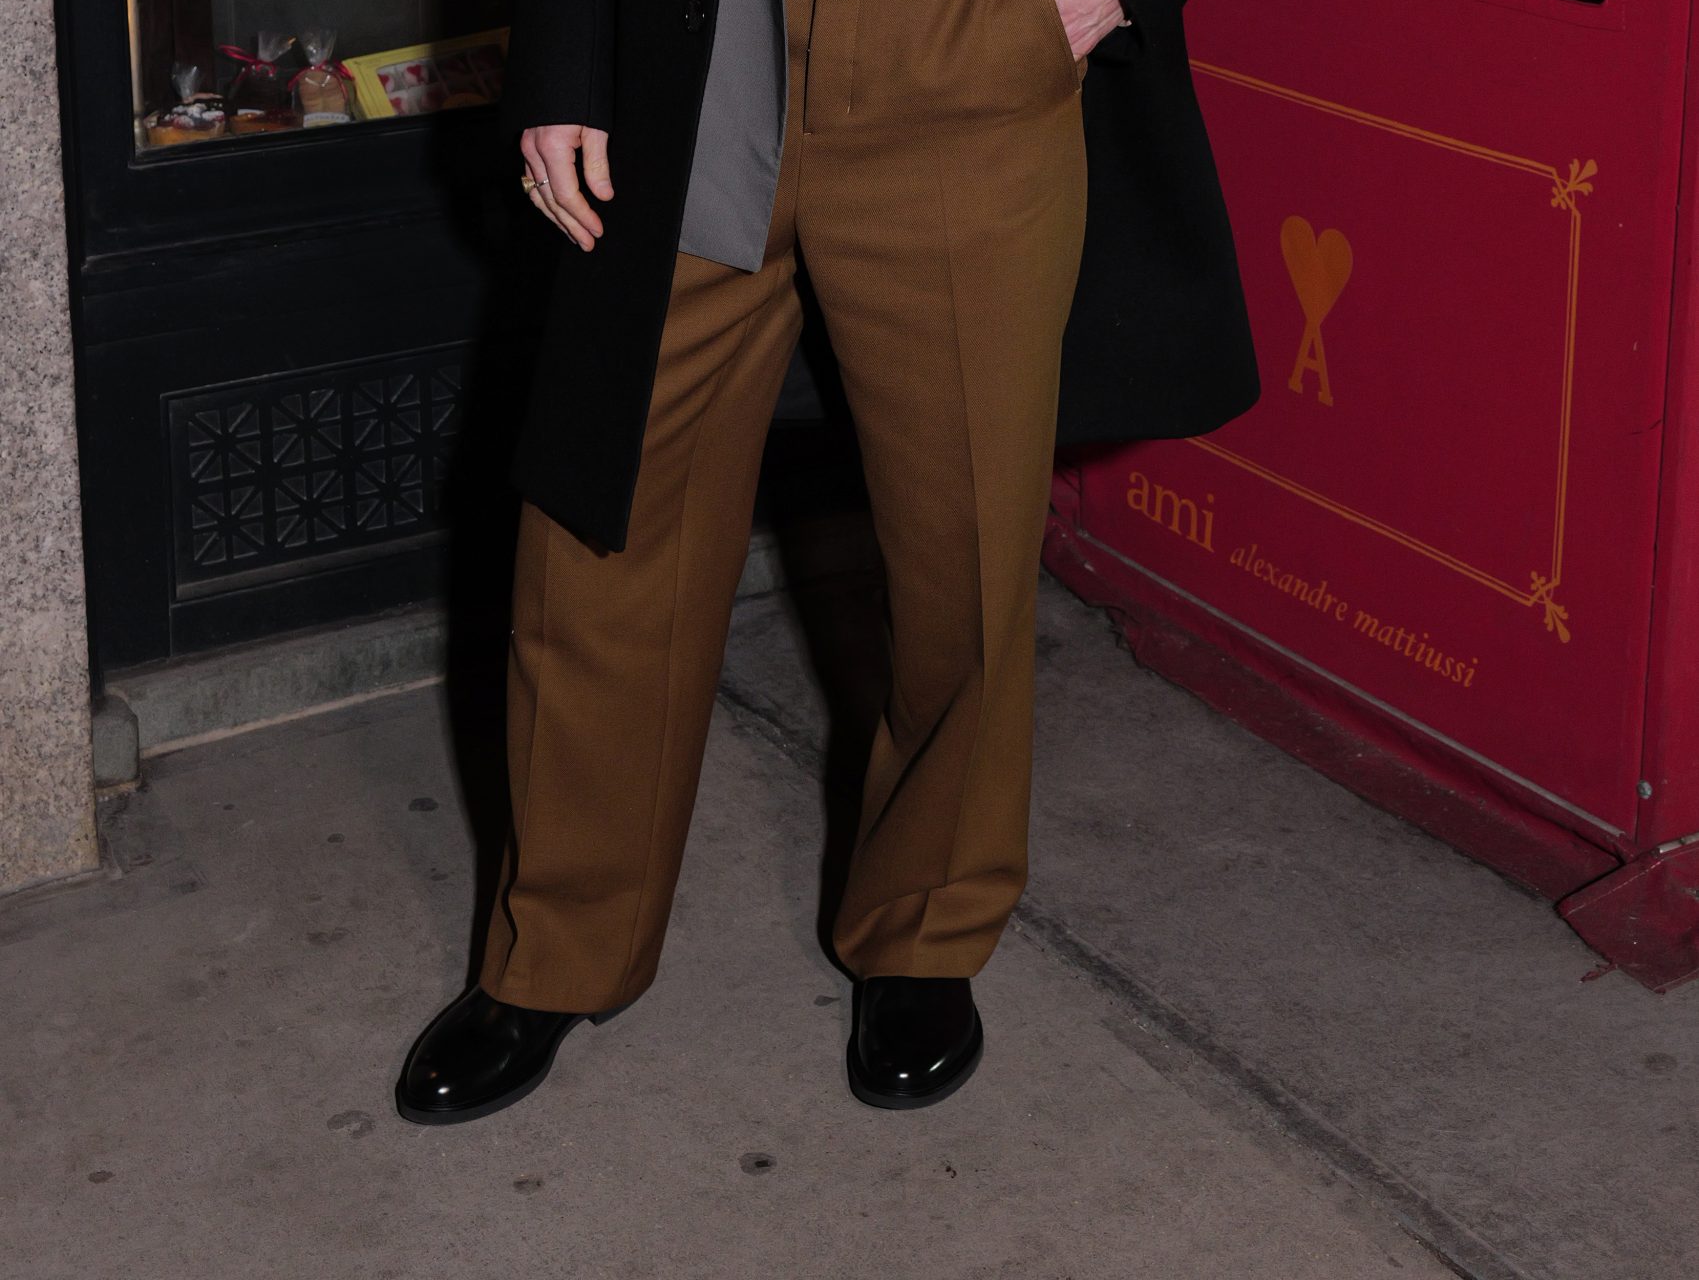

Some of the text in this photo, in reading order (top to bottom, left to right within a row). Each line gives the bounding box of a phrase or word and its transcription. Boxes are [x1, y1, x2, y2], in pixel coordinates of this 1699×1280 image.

[1127, 471, 1480, 688] ami alexandre mattiussi
